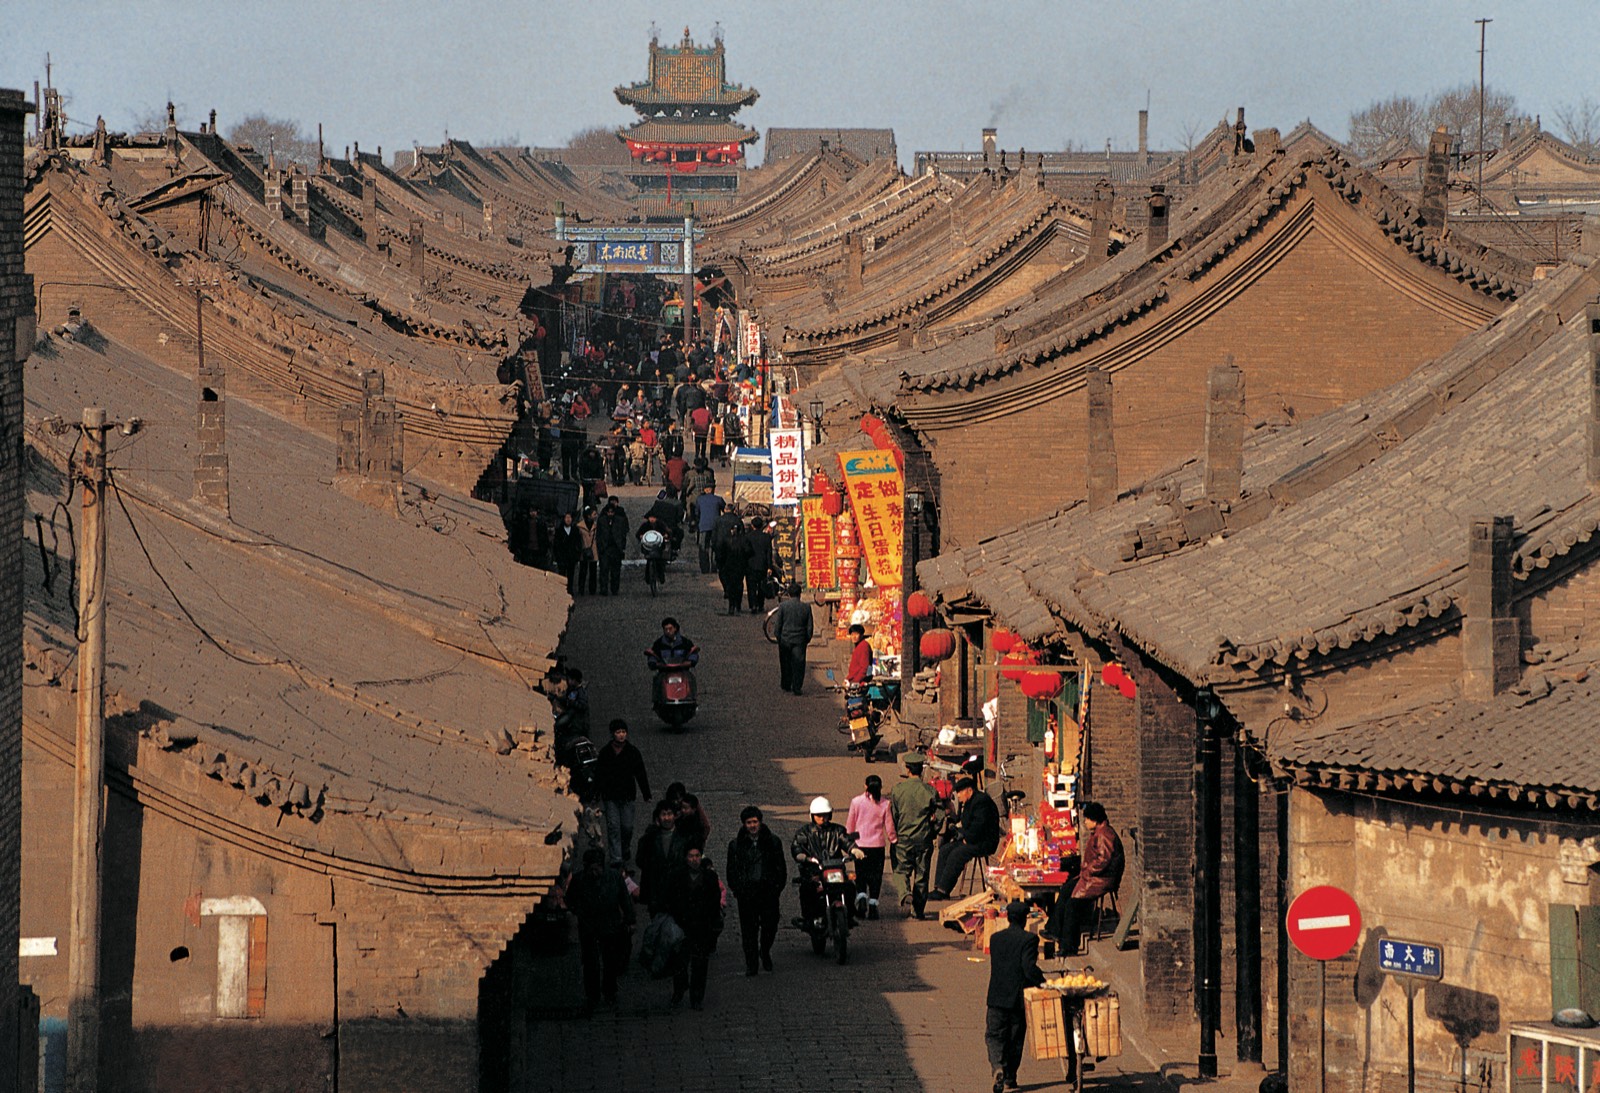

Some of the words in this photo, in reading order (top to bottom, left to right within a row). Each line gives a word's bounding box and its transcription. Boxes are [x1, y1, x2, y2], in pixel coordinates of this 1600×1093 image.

[774, 435, 798, 500] 精品饼屋
[807, 517, 831, 588] 生日蛋糕
[863, 504, 894, 577] 生日蛋糕
[1384, 942, 1435, 965] 南大街
